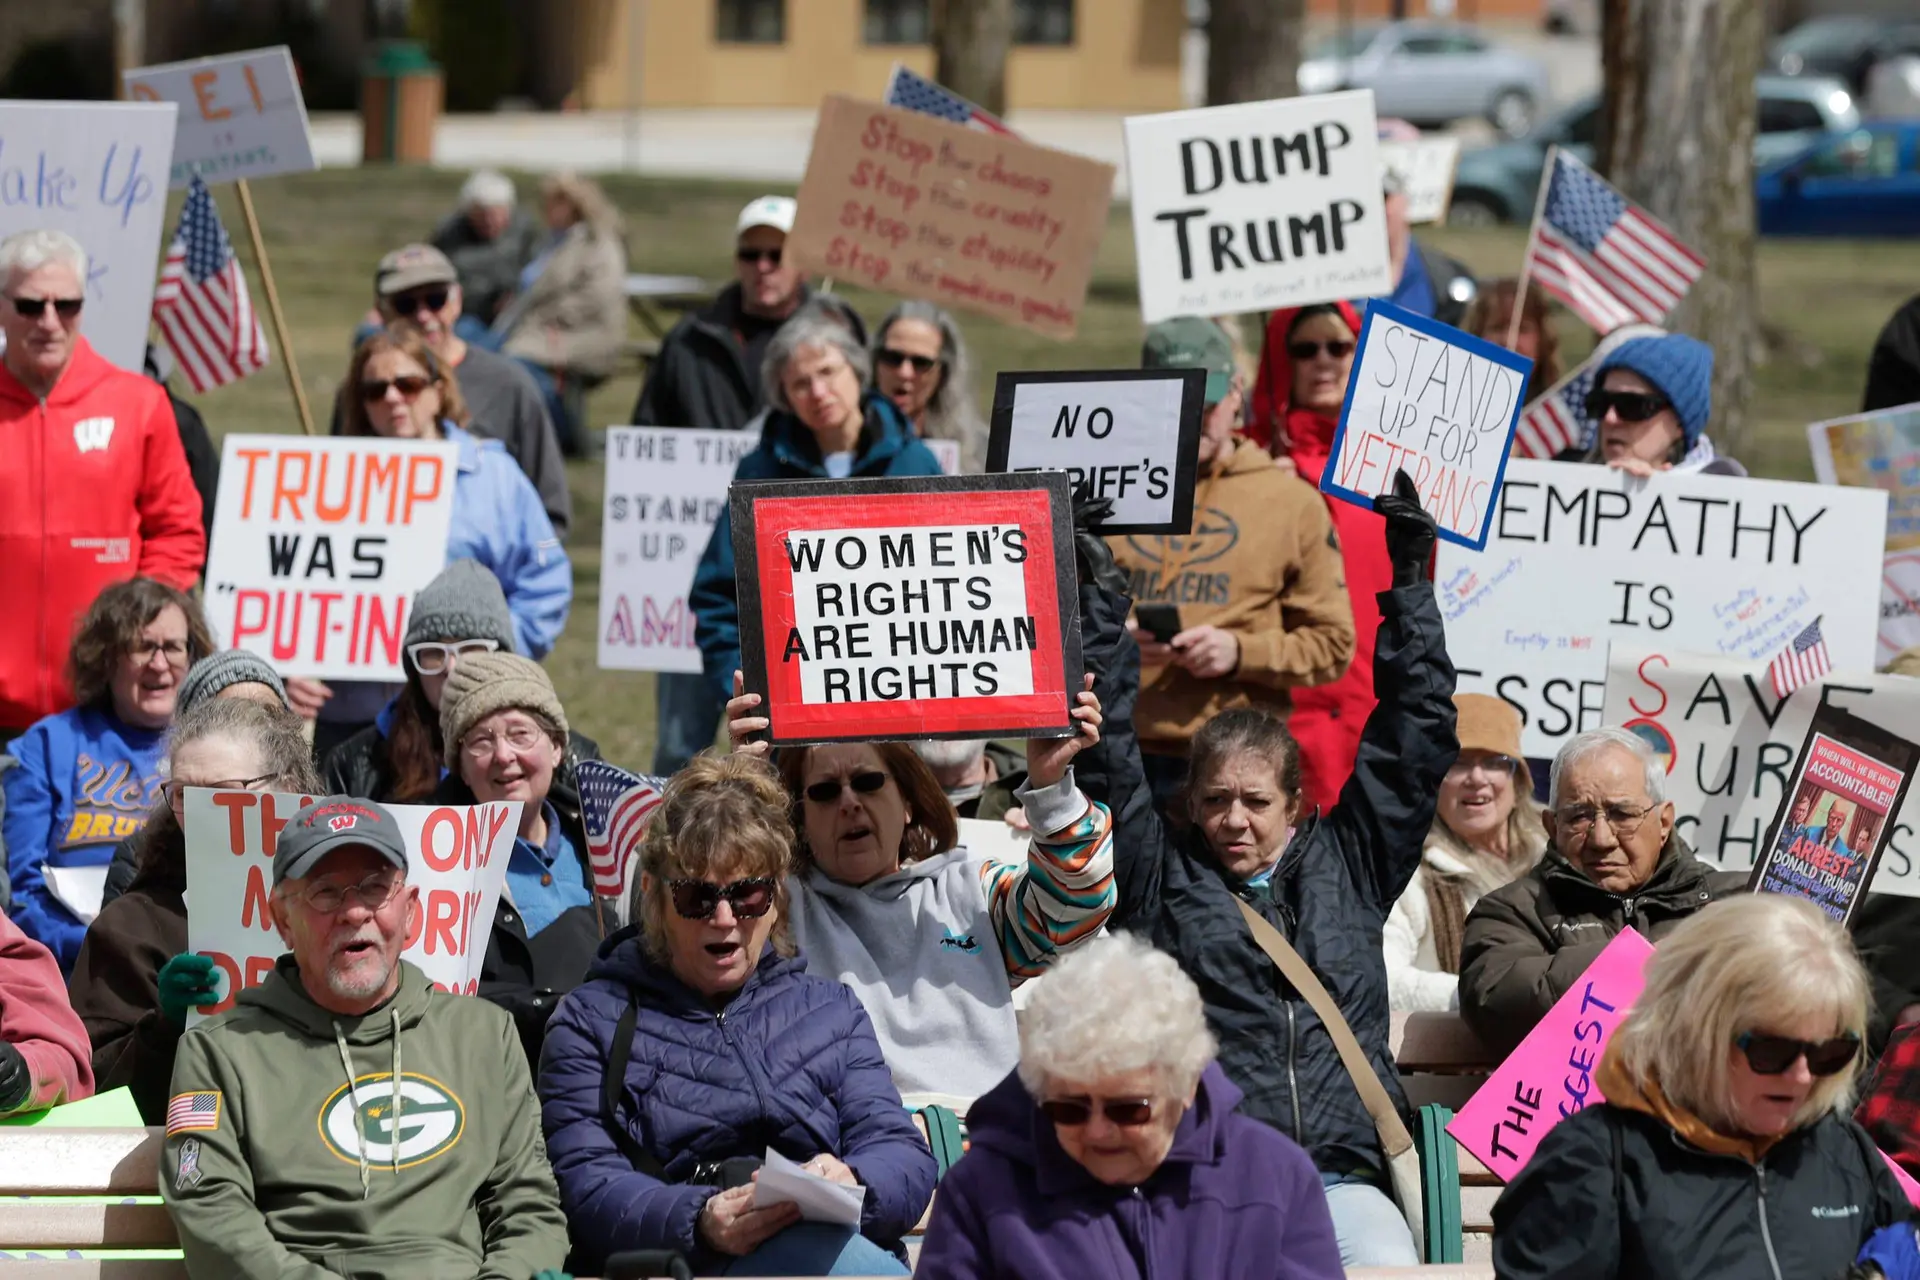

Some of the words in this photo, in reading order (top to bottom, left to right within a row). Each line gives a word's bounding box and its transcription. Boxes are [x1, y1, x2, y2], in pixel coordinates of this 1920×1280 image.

[861, 114, 934, 177] Stop
[938, 139, 974, 172] the
[977, 154, 1053, 196] chaos
[1180, 120, 1352, 197] DUMP
[0, 137, 78, 211] ake
[100, 141, 154, 228] Up
[849, 158, 921, 213] Stop
[930, 181, 968, 211] the
[971, 203, 1067, 250] cruelty
[838, 200, 911, 250] Stop
[917, 222, 955, 249] the
[1154, 197, 1366, 281] TRUMP
[824, 236, 892, 284] Stop
[1374, 324, 1513, 433] STAND
[1051, 404, 1115, 440] NO
[1378, 395, 1418, 439] UP
[1424, 414, 1479, 470] FOR
[613, 433, 678, 463] THE
[235, 448, 444, 526] TRUMP
[1012, 457, 1170, 500] RIFF'S
[610, 494, 726, 524] STAND
[1498, 480, 1828, 565] EMPATHY
[268, 533, 388, 580] WAS
[639, 531, 687, 563] UP
[783, 526, 1029, 573] WOMEN'S
[815, 576, 993, 619] RIGHTS
[1129, 569, 1231, 605] ACKERS
[1609, 579, 1675, 631] IS
[782, 621, 873, 664] ARE
[890, 615, 1039, 658] HUMAN
[1570, 635, 1592, 650] NOT
[824, 660, 1001, 705] RIGHTS
[1816, 744, 1840, 764] WHEN
[1838, 753, 1858, 772] WILL
[1855, 763, 1869, 777] HE
[1866, 769, 1880, 783] BE
[1877, 773, 1897, 790] HELD
[66, 811, 147, 841] BRU
[212, 792, 314, 857] TH
[328, 814, 358, 833] W
[1772, 863, 1792, 879] FOR
[1772, 848, 1819, 880] DONALD
[1817, 870, 1857, 898] TRUMP
[1788, 835, 1855, 879] ARREST
[1763, 875, 1783, 893] THE
[1490, 1080, 1543, 1162] THE
